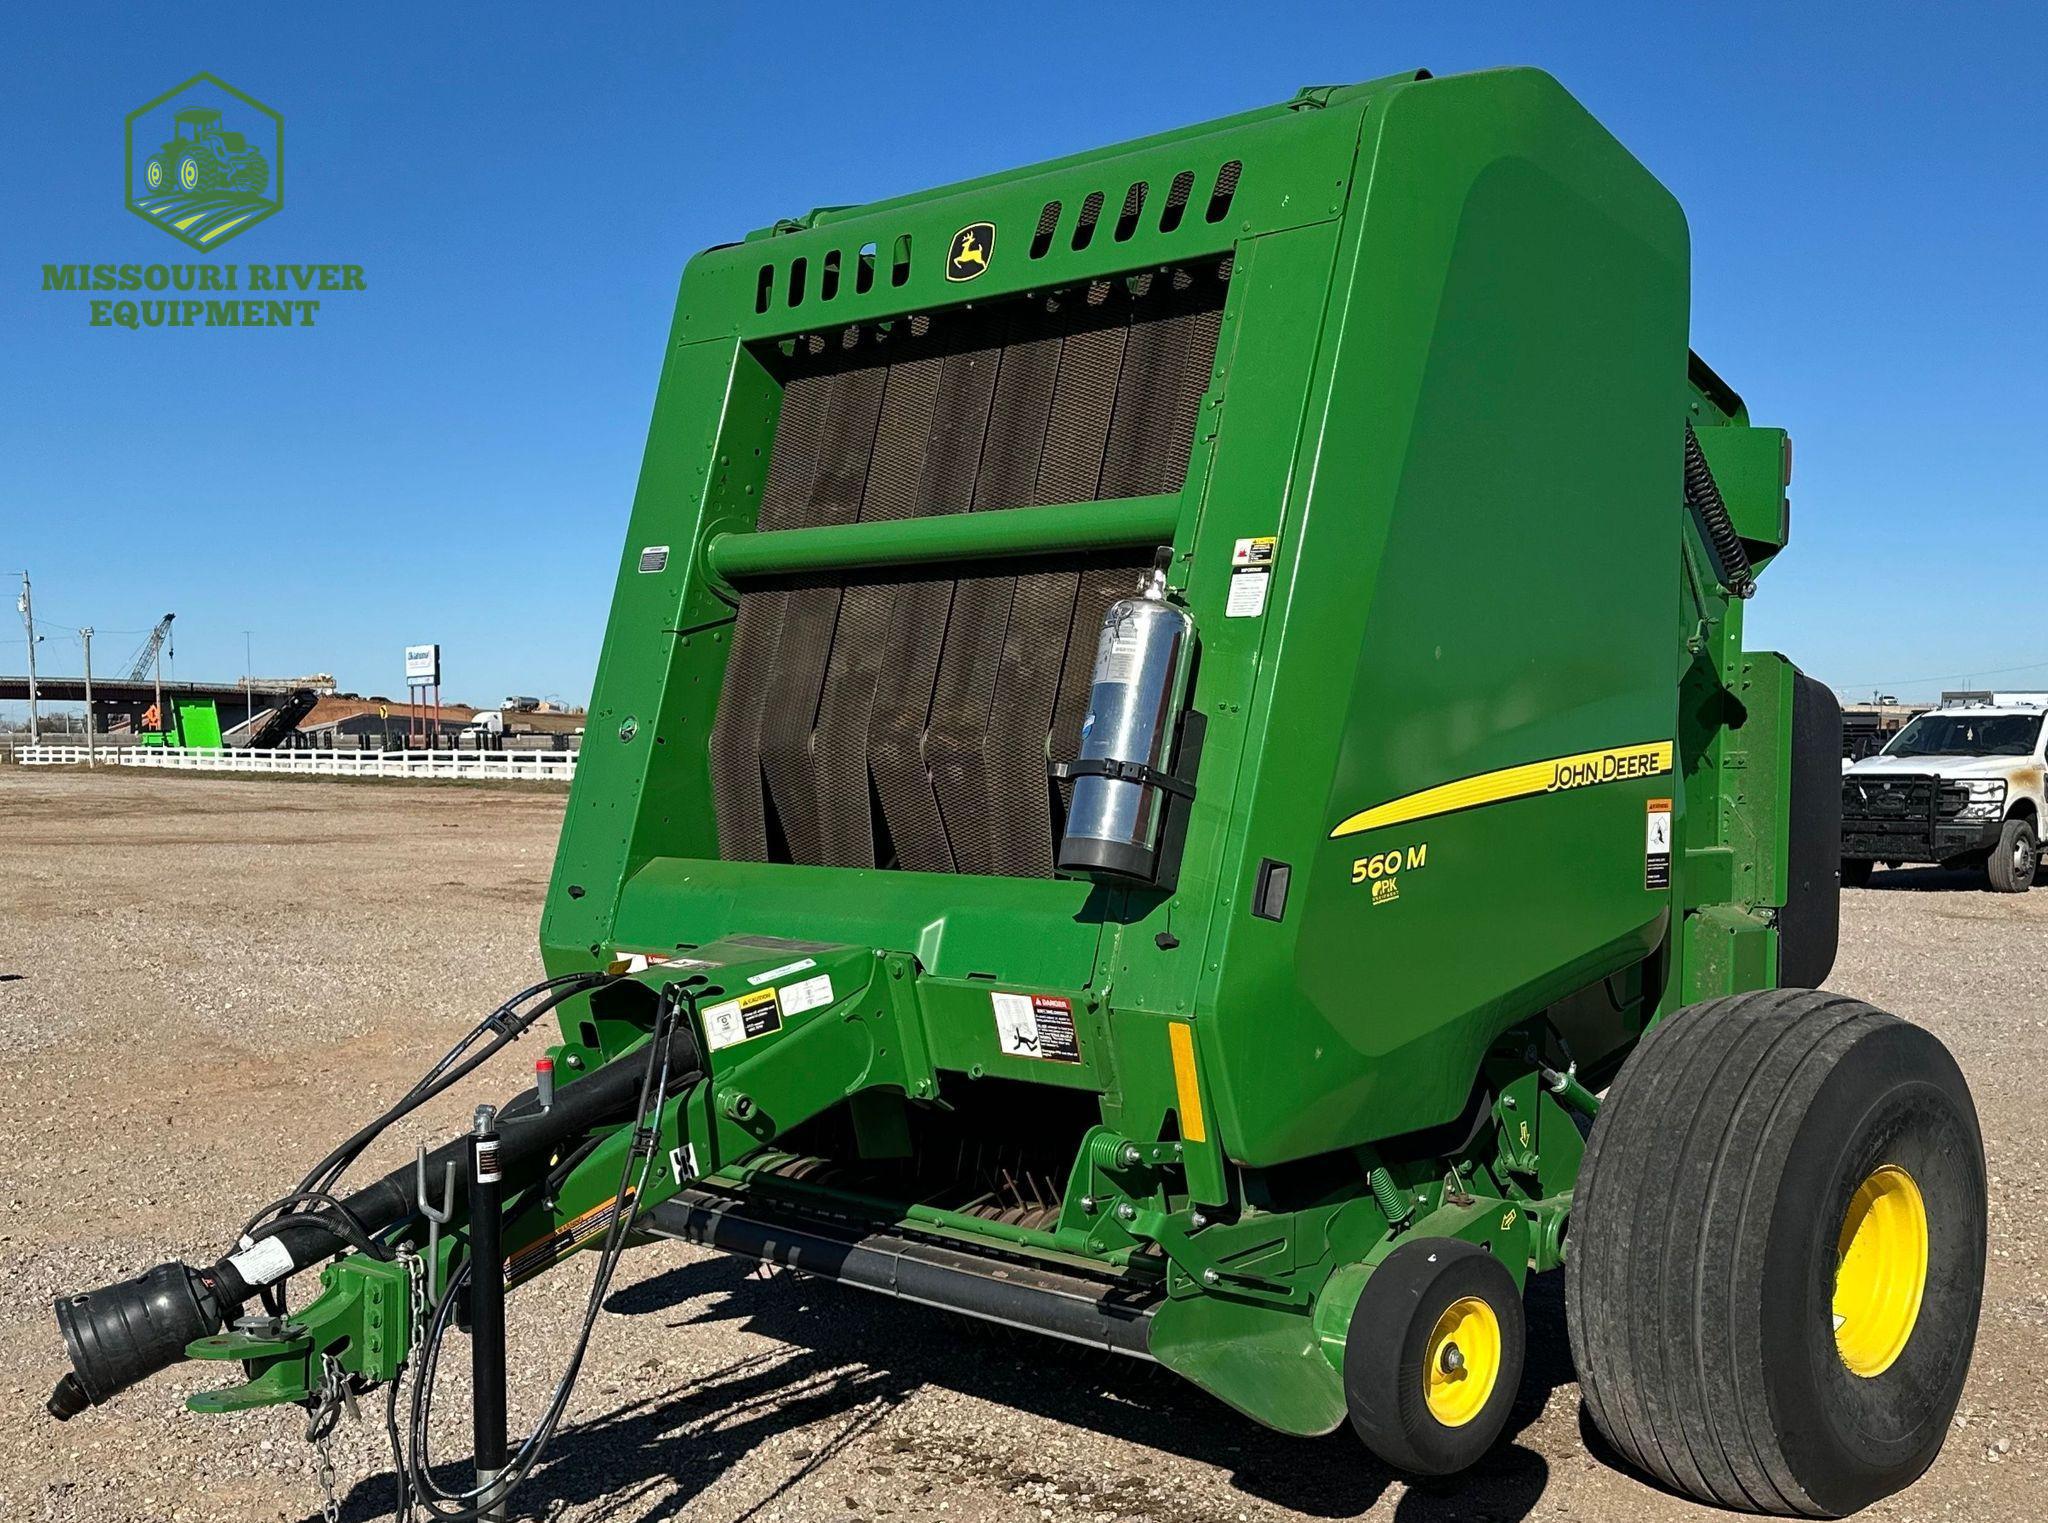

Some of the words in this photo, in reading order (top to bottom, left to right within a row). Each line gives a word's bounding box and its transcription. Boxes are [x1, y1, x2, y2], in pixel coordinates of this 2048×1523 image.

[1547, 761, 1599, 789] JOHN
[1602, 752, 1660, 779] DEERE
[1352, 850, 1402, 884] 560
[1406, 843, 1428, 870] M
